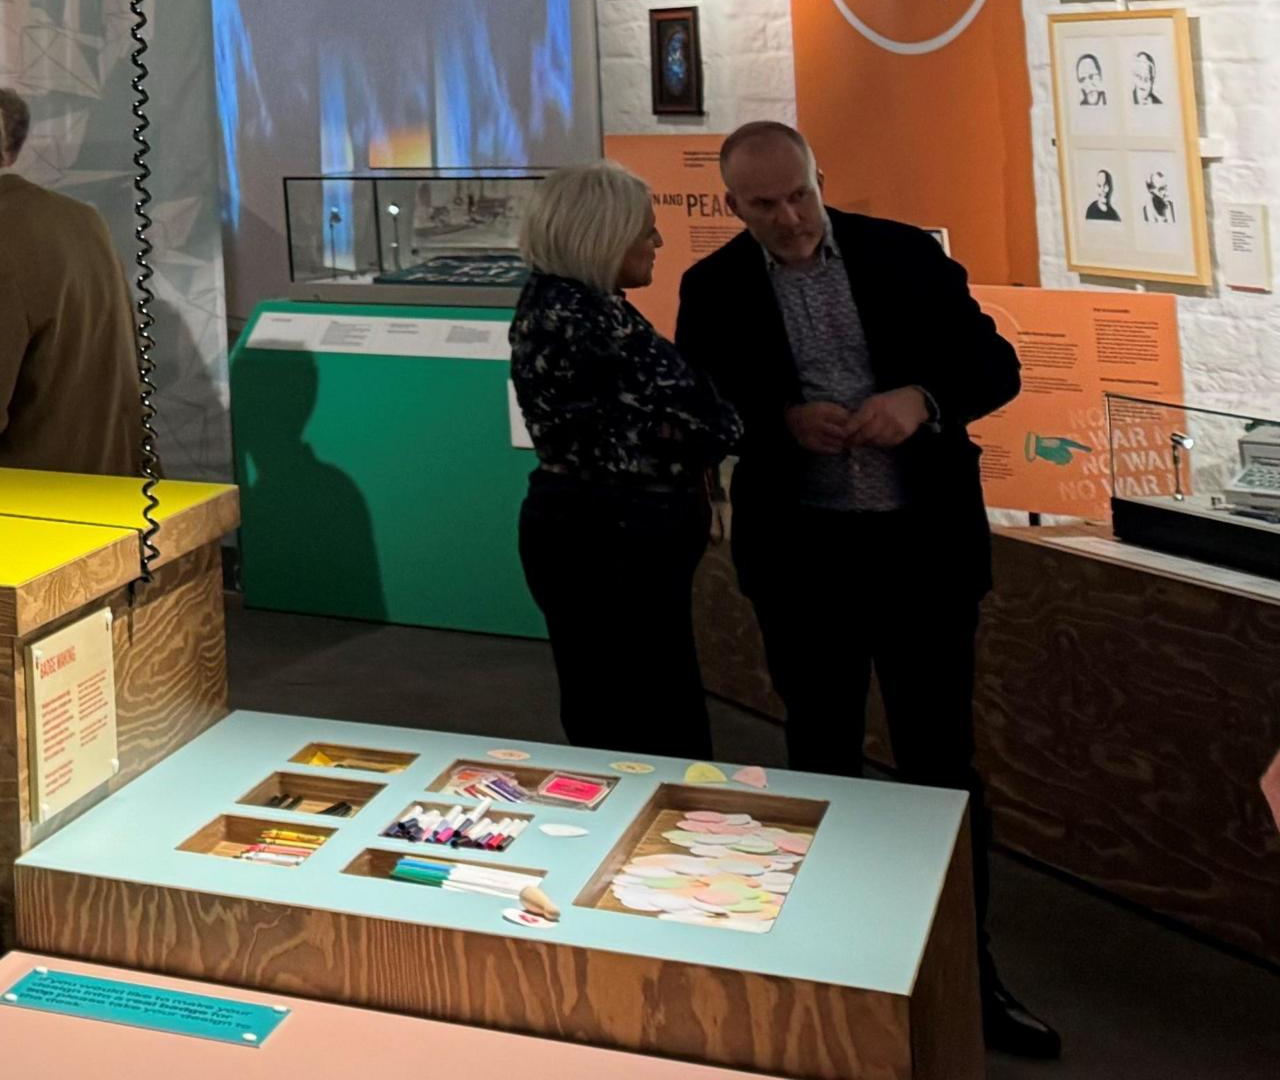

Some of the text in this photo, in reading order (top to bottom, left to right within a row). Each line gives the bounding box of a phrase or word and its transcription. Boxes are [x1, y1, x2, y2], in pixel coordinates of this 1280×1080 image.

[1090, 426, 1153, 450] WAR
[1101, 473, 1162, 499] WAR
[80, 983, 125, 994] would
[172, 999, 215, 1010] make
